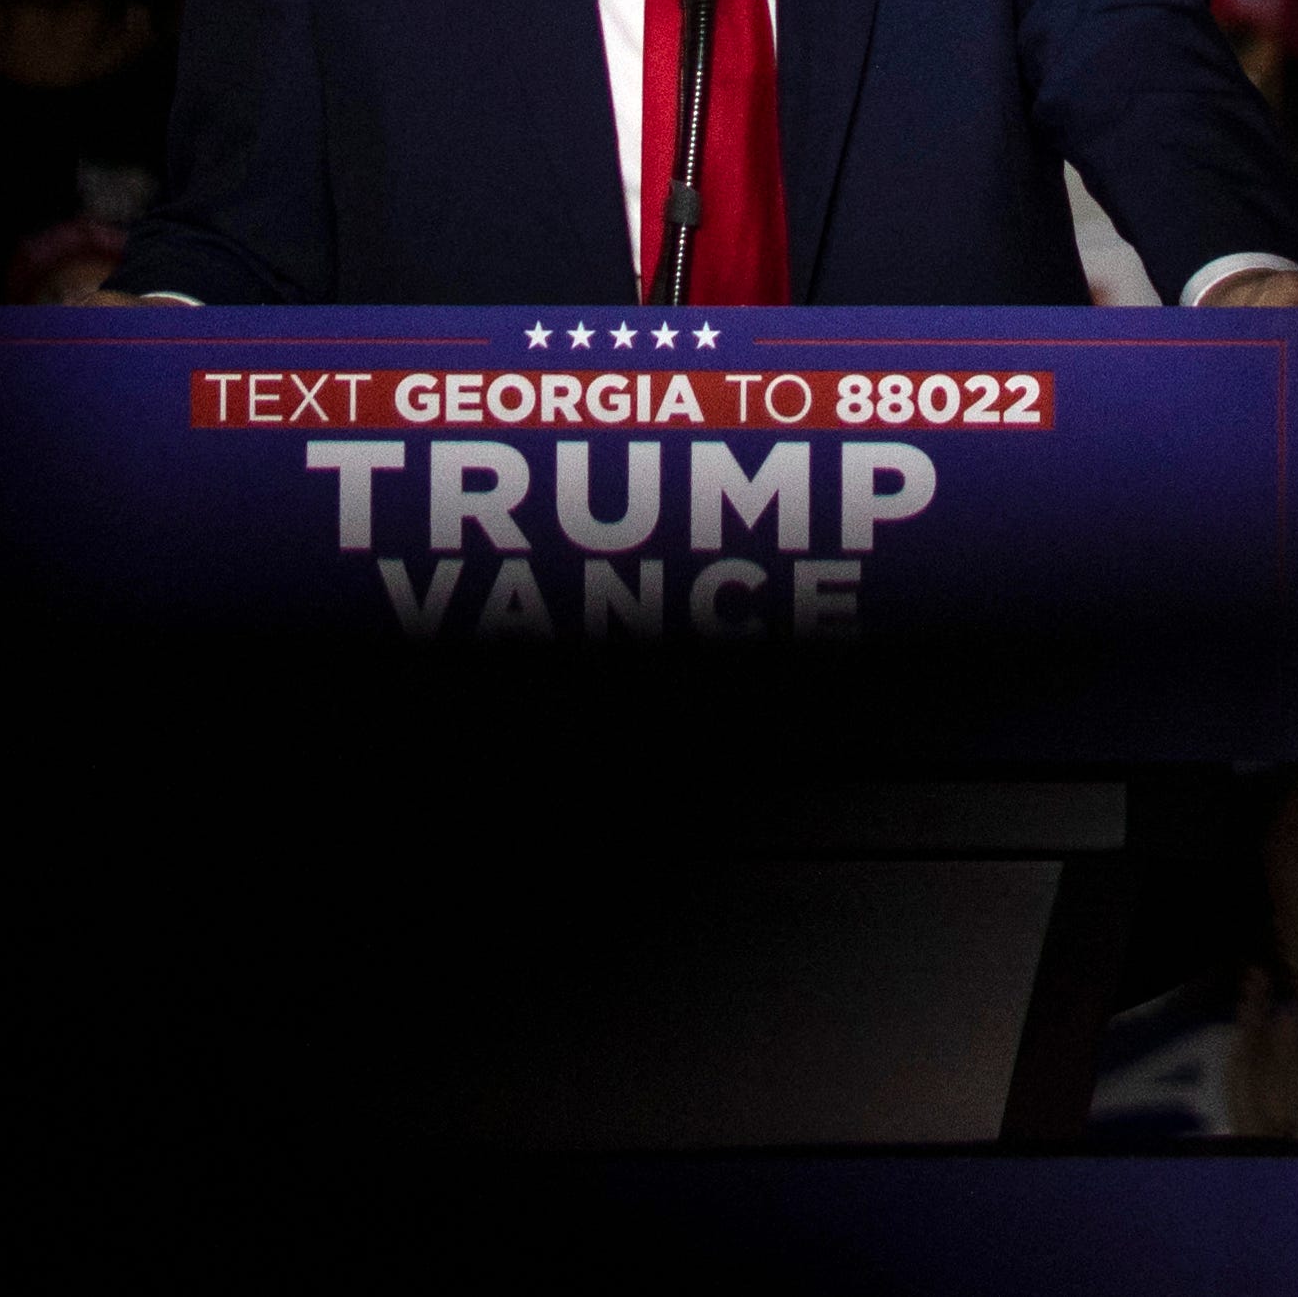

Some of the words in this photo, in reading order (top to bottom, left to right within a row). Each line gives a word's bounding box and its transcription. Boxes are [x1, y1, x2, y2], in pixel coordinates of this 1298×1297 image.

[205, 373, 372, 422] TEXT
[394, 373, 705, 424] GEORGIA
[725, 373, 813, 424] TO
[835, 373, 1041, 424] 88022
[305, 439, 937, 551] TRUMP
[376, 557, 863, 639] VANCE
